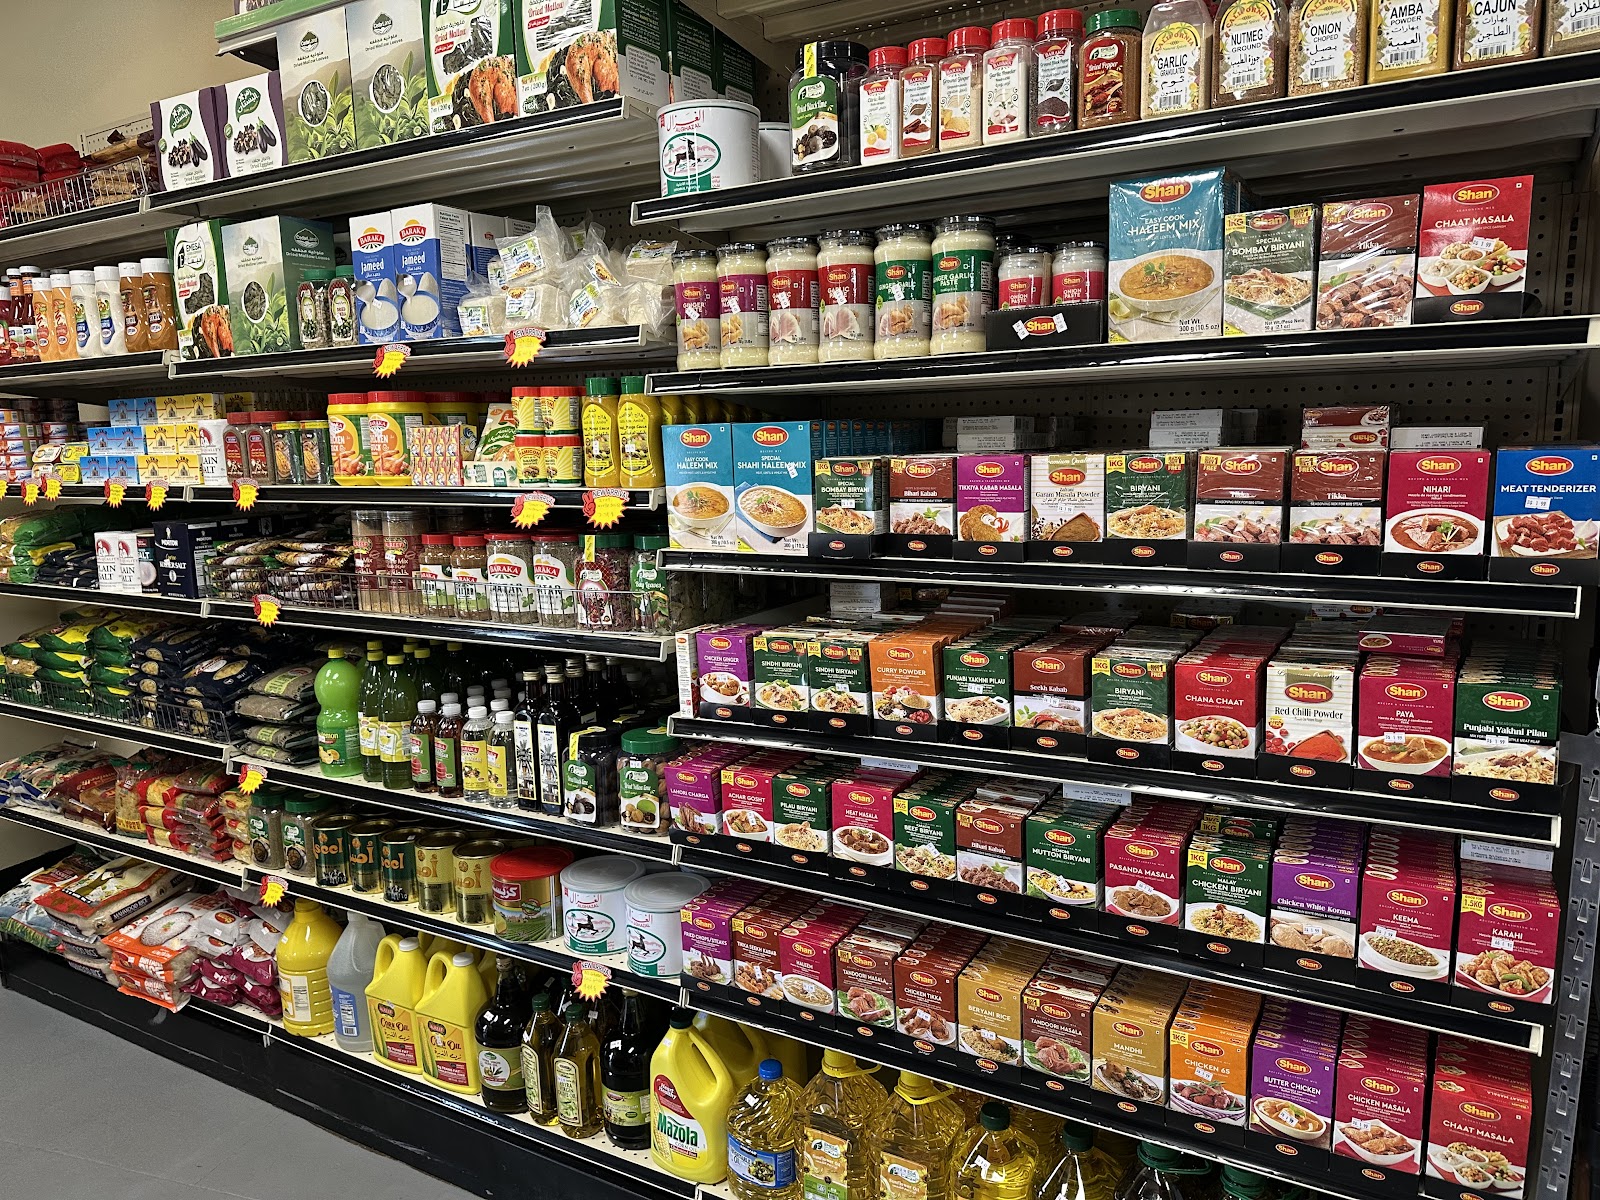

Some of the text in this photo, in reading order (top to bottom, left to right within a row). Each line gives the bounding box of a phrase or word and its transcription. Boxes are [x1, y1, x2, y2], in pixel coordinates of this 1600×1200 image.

[528, 7, 544, 18] Dried
[1390, 2, 1424, 20] AMBA
[1474, 0, 1516, 17] CAJUN
[1225, 5, 1268, 29] CALIFORNIA
[1390, 15, 1422, 26] POWDER
[1310, 22, 1342, 37] ONION
[1231, 28, 1264, 46] NUTMEG
[1313, 34, 1339, 43] CHOPED
[1231, 42, 1262, 53] GROUND
[1309, 43, 1338, 56] بصل
[1157, 53, 1188, 70] GARLIC
[1160, 75, 1185, 89] ثوم
[667, 109, 705, 132] الغزال
[1144, 182, 1185, 200] Shan
[1458, 187, 1494, 202] Shan
[1145, 213, 1185, 225] EASY COOK
[1435, 214, 1514, 229] CHAAT MASALA
[401, 227, 426, 238] BARAKA
[1130, 218, 1200, 236] HALEEM MIX
[360, 234, 384, 245] BARAKA
[1256, 236, 1282, 245] SPECIAL
[1232, 240, 1305, 256] BOMBAY BIRYANI
[401, 251, 426, 268] Jameed
[361, 258, 385, 275] Jameed
[1026, 318, 1056, 332] Shan
[513, 330, 526, 339] NEW
[682, 432, 708, 443] Shan
[757, 430, 785, 442] Shan
[676, 461, 719, 470] HALEEM MIX
[834, 465, 855, 474] Shan
[908, 464, 934, 475] Shan
[978, 465, 1001, 475] Shan
[1108, 460, 1123, 468] 1KG
[1131, 460, 1158, 471] Shan
[1320, 460, 1353, 472] Shan
[1422, 460, 1455, 471] Shan
[1530, 459, 1567, 472] Shan
[1051, 471, 1082, 483] Shan
[592, 488, 629, 499] NEW ARRIVAL
[821, 486, 870, 494] BOMBAY BIRYANI
[1130, 484, 1161, 493] BIRYANI
[1423, 485, 1451, 493] NIHARI
[1501, 484, 1597, 493] MEAT TENDERIZER
[1077, 491, 1100, 499] Powder
[489, 565, 519, 575] BARAKA
[888, 649, 912, 659] Shan
[962, 654, 986, 665] Shan
[1034, 660, 1061, 670] Shan
[1115, 664, 1143, 675] Shan
[898, 668, 927, 676] POWDER
[1199, 672, 1229, 684] Shan
[946, 674, 968, 682] PUNJABI
[989, 677, 1006, 685] PILAU
[1029, 684, 1068, 693] Seekh Kabab
[1114, 687, 1144, 696] BIRYANI
[1287, 686, 1327, 700] Shan
[1389, 686, 1422, 698] Shan
[1185, 694, 1244, 707] CHANA CHAAT
[1487, 694, 1526, 708] Shan
[1274, 706, 1344, 720] Red Chilli Powder
[1396, 709, 1415, 719] PAYA
[1463, 723, 1548, 738] Punjabi Yakhni Pilau
[670, 788, 709, 800] LAHORI CHARGA
[728, 792, 766, 803] ACHAR GOSHT
[780, 802, 818, 813] PILAU BIRYANI
[911, 808, 934, 819] Shan
[904, 824, 943, 837] BEEF BIRYANI
[975, 819, 1001, 833] Shan
[1047, 832, 1072, 844] Shan
[1032, 848, 1091, 864] MUTTON BIRYANI
[1127, 845, 1154, 858] Shan
[1190, 853, 1205, 863] 1KG
[1109, 863, 1175, 880] PASANDA MASALA
[1212, 859, 1241, 872] Shan
[1192, 878, 1262, 897] CHICKEN BIRYANI
[1217, 877, 1236, 886] MALAY
[1297, 875, 1331, 890] Shan
[1391, 891, 1424, 905] Shan
[1464, 899, 1483, 909] 1.5KG
[113, 898, 149, 921] MAHMOOD RICE
[1277, 896, 1352, 916] Chicken White Korma
[1491, 904, 1527, 920] Shan
[1393, 913, 1419, 925] KEEMA
[1492, 928, 1523, 940] KARAHI
[977, 990, 1001, 1002] Shan
[968, 1004, 1012, 1022] BERYANI RICE
[1044, 1006, 1068, 1018] Shan
[380, 1017, 410, 1032] CORN OIL
[1030, 1017, 1083, 1036] TANDOORI MASALA
[1115, 1023, 1141, 1037] Shan
[447, 1040, 462, 1051] OIL
[1113, 1043, 1143, 1055] MANDHI
[1193, 1042, 1222, 1056] Shan
[1184, 1057, 1231, 1075] CHICKEN 65
[1278, 1059, 1308, 1074] Shan
[1263, 1075, 1321, 1096] BUTTER CHICKEN
[1363, 1077, 1395, 1094] Shan
[1347, 1093, 1411, 1115] CHICKEN MASALA
[1461, 1103, 1497, 1120] Shan
[657, 1112, 698, 1146] Mazola
[1443, 1118, 1514, 1145] CHAAT MASALA
